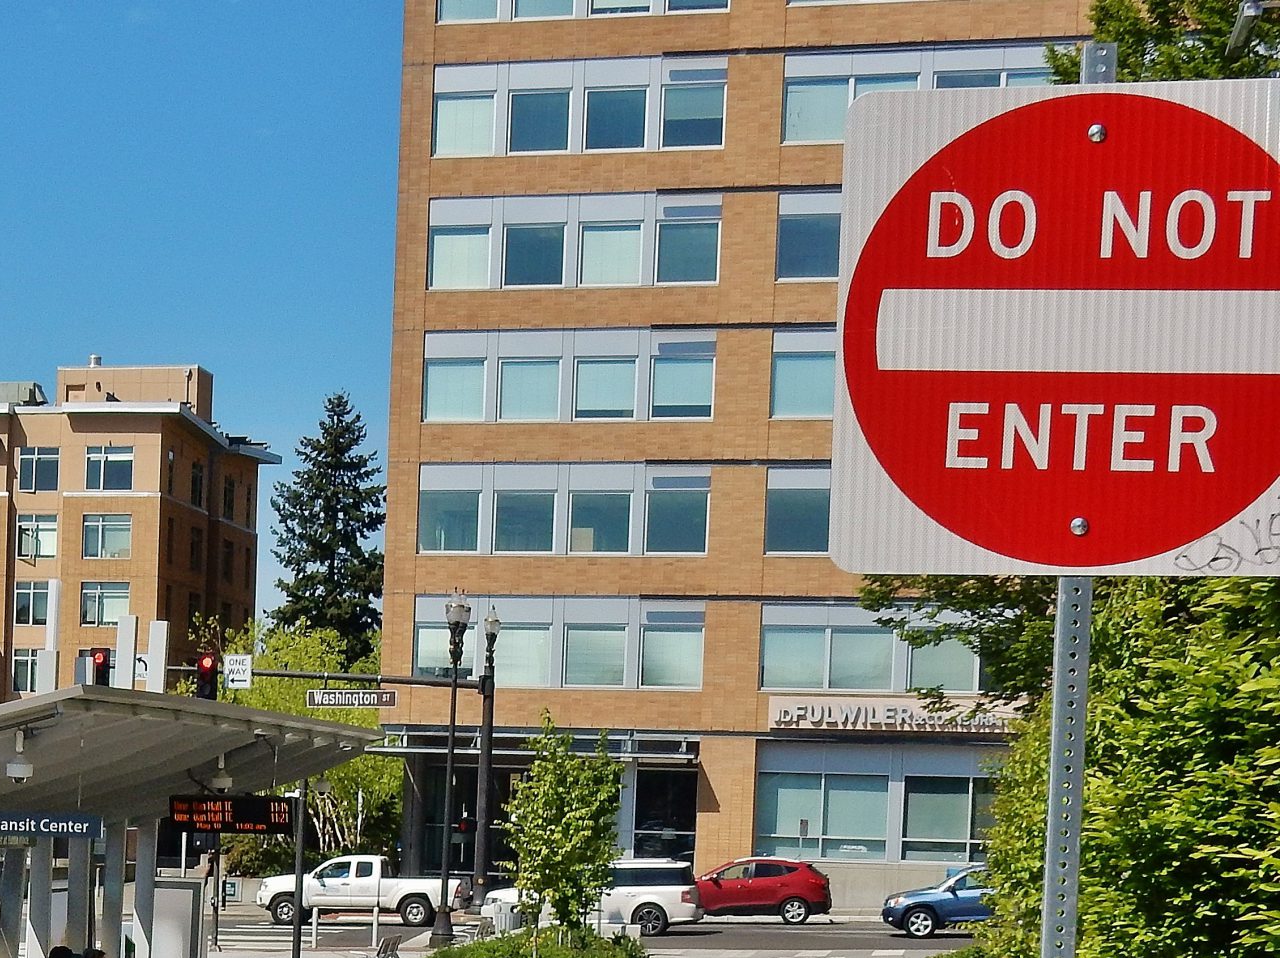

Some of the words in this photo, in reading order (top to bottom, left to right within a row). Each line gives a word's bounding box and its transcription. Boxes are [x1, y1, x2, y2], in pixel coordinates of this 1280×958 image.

[926, 190, 1037, 259] DO
[1100, 190, 1272, 259] NOT
[945, 402, 1218, 473] ENTER
[229, 658, 246, 666] ONE
[314, 691, 378, 706] Washington
[225, 801, 233, 811] TC
[225, 812, 233, 822] TC
[40, 819, 89, 833] Center
